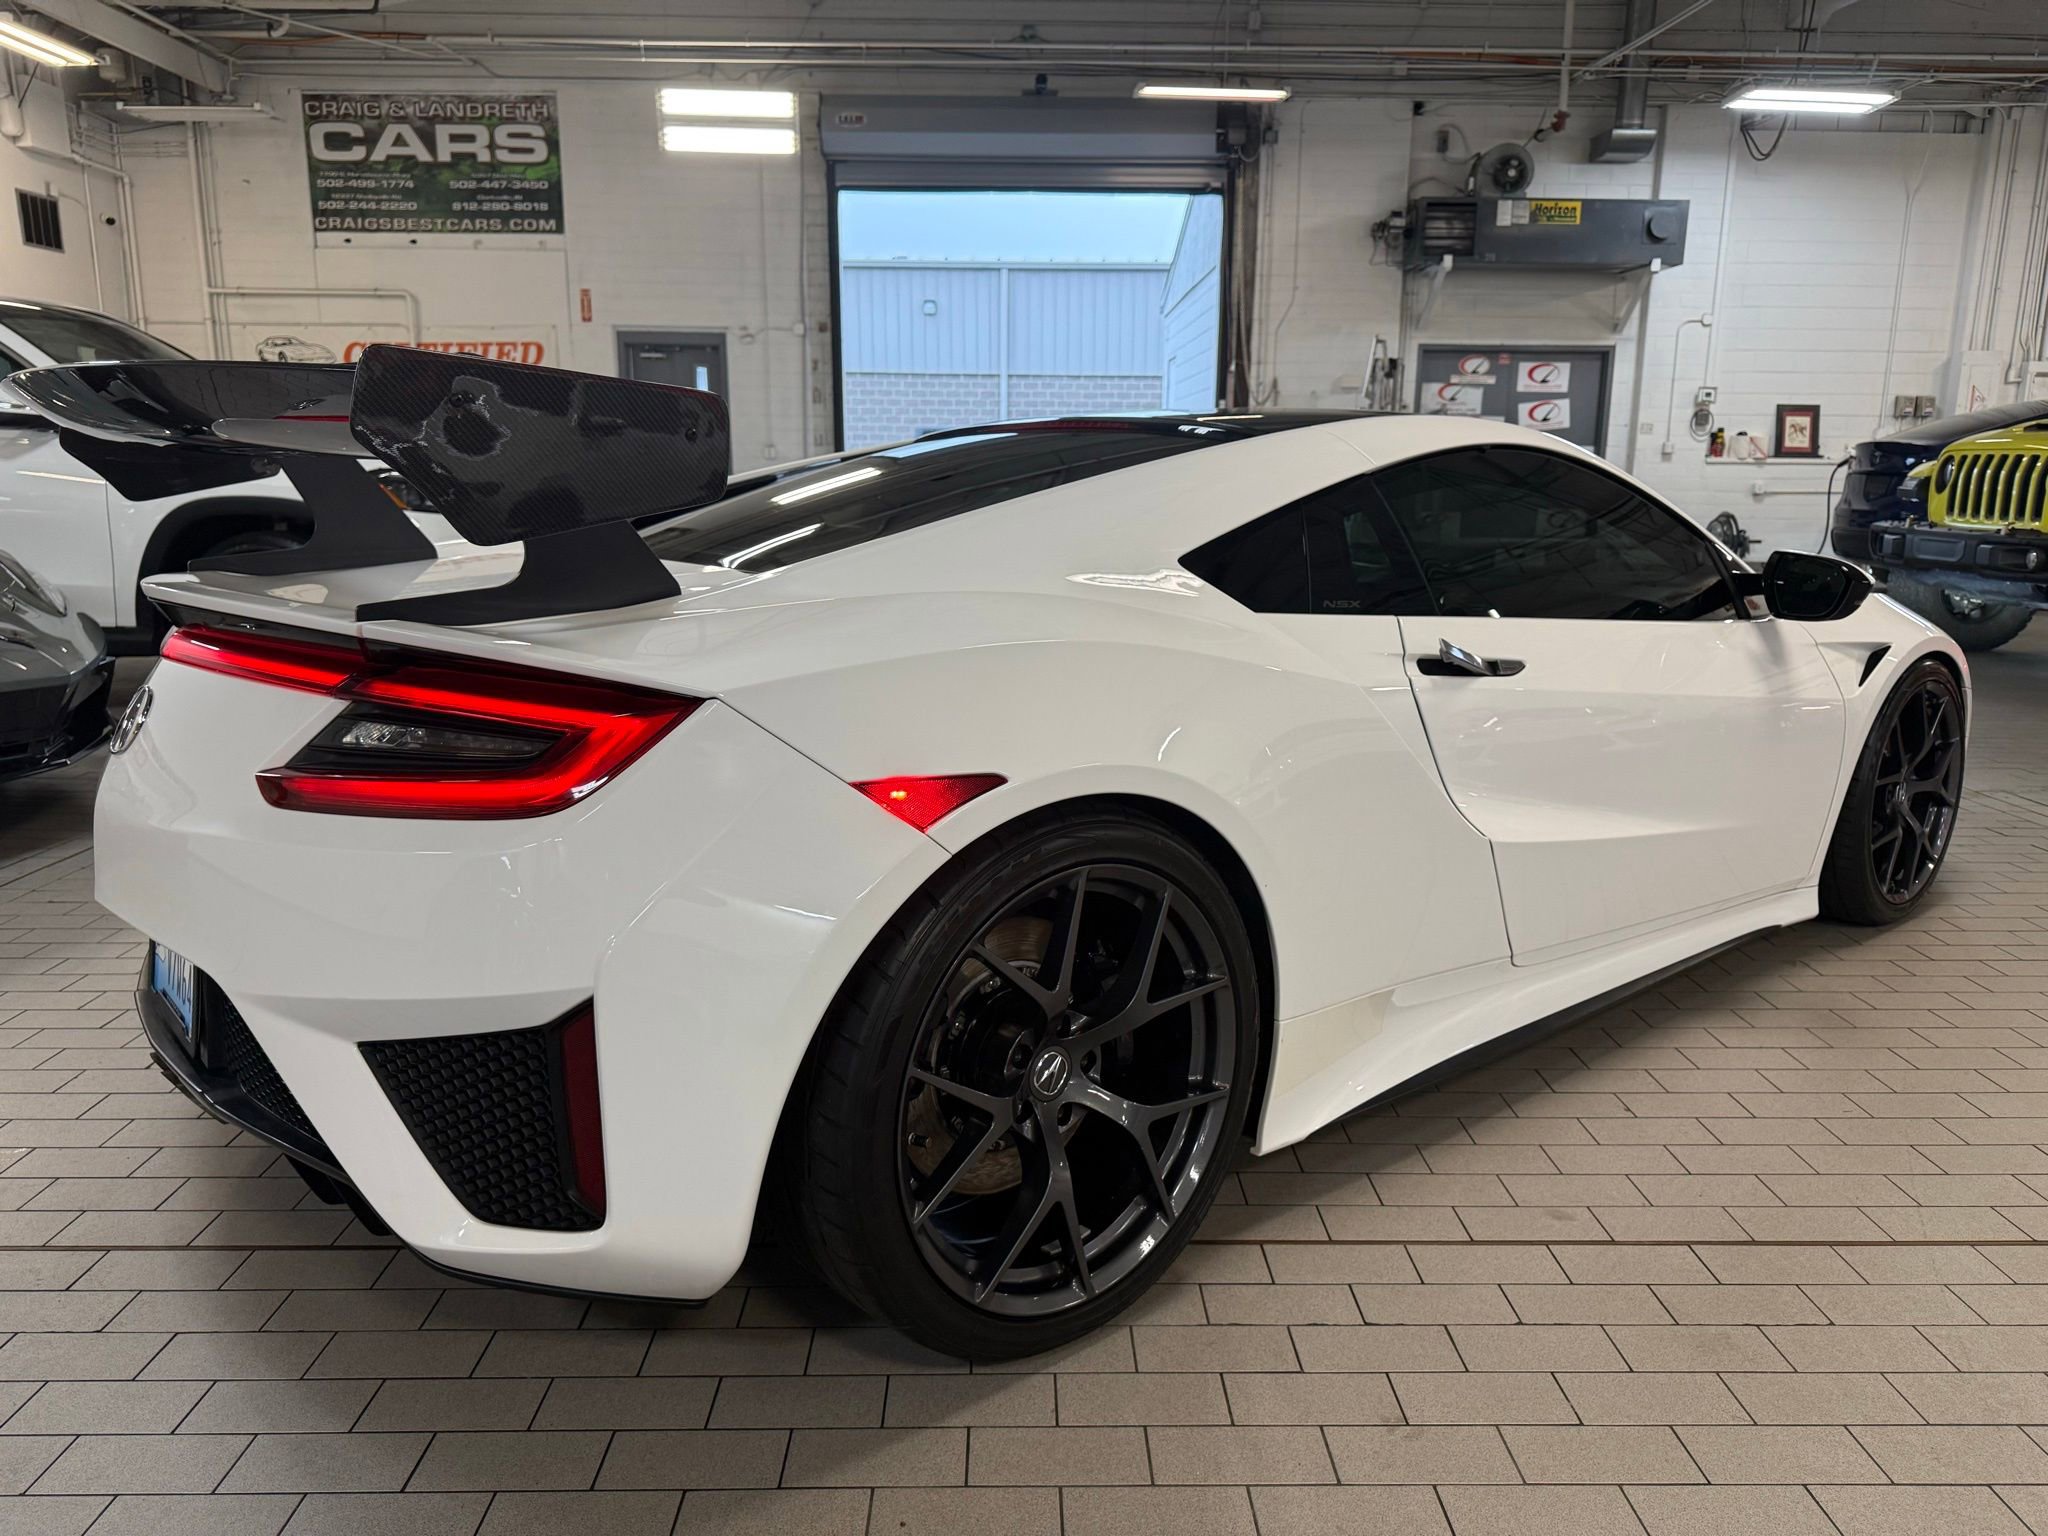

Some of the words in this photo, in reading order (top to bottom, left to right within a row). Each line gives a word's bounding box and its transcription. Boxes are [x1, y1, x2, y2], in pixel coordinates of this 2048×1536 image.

[304, 101, 380, 117] CRAIG
[390, 102, 406, 117] &
[415, 102, 549, 118] LANDRETH
[309, 122, 549, 163] CARS
[316, 179, 415, 189] 502-499-1774
[314, 216, 557, 232] CRAIGSBESTCARS.COM
[1322, 600, 1361, 609] NSX
